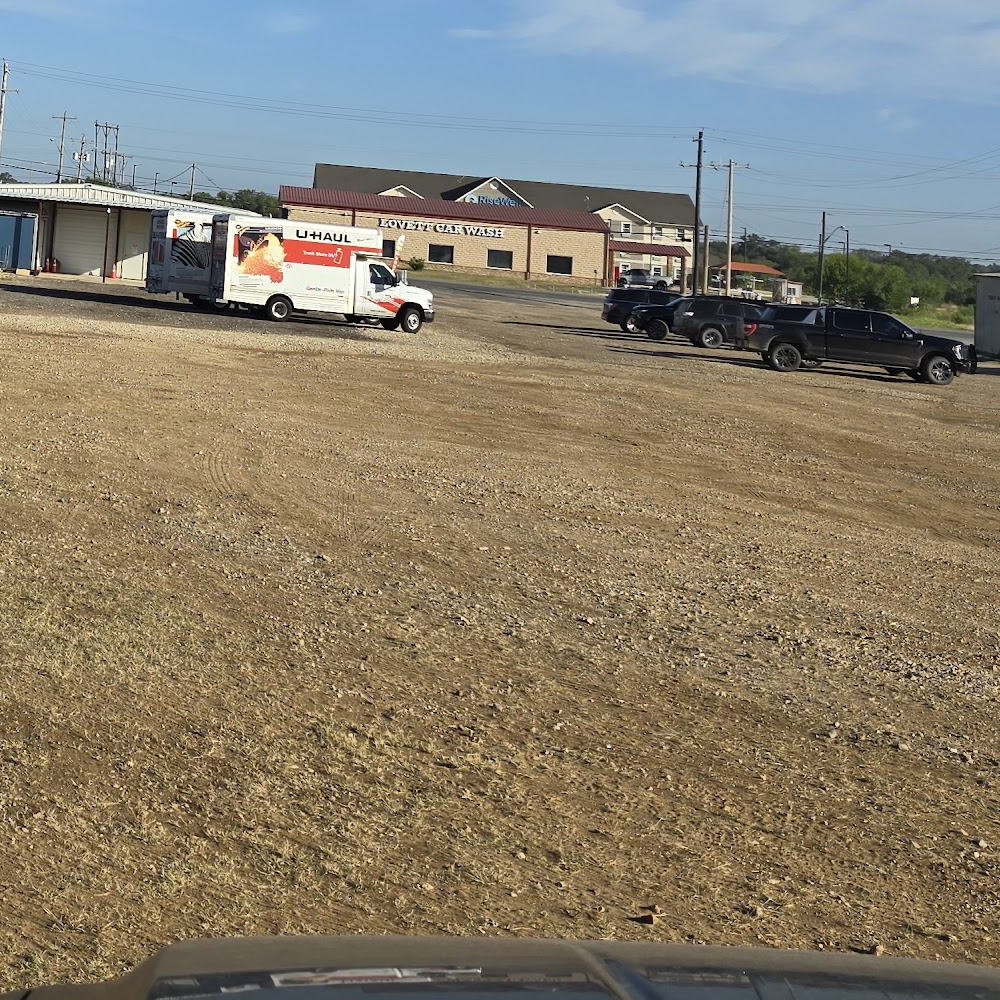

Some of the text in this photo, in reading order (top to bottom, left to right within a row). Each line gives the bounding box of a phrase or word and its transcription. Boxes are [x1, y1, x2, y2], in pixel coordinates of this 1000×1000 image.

[478, 195, 520, 207] RiseWel
[379, 218, 505, 238] LOVETT CAR WASH
[296, 229, 352, 243] U-HAUL
